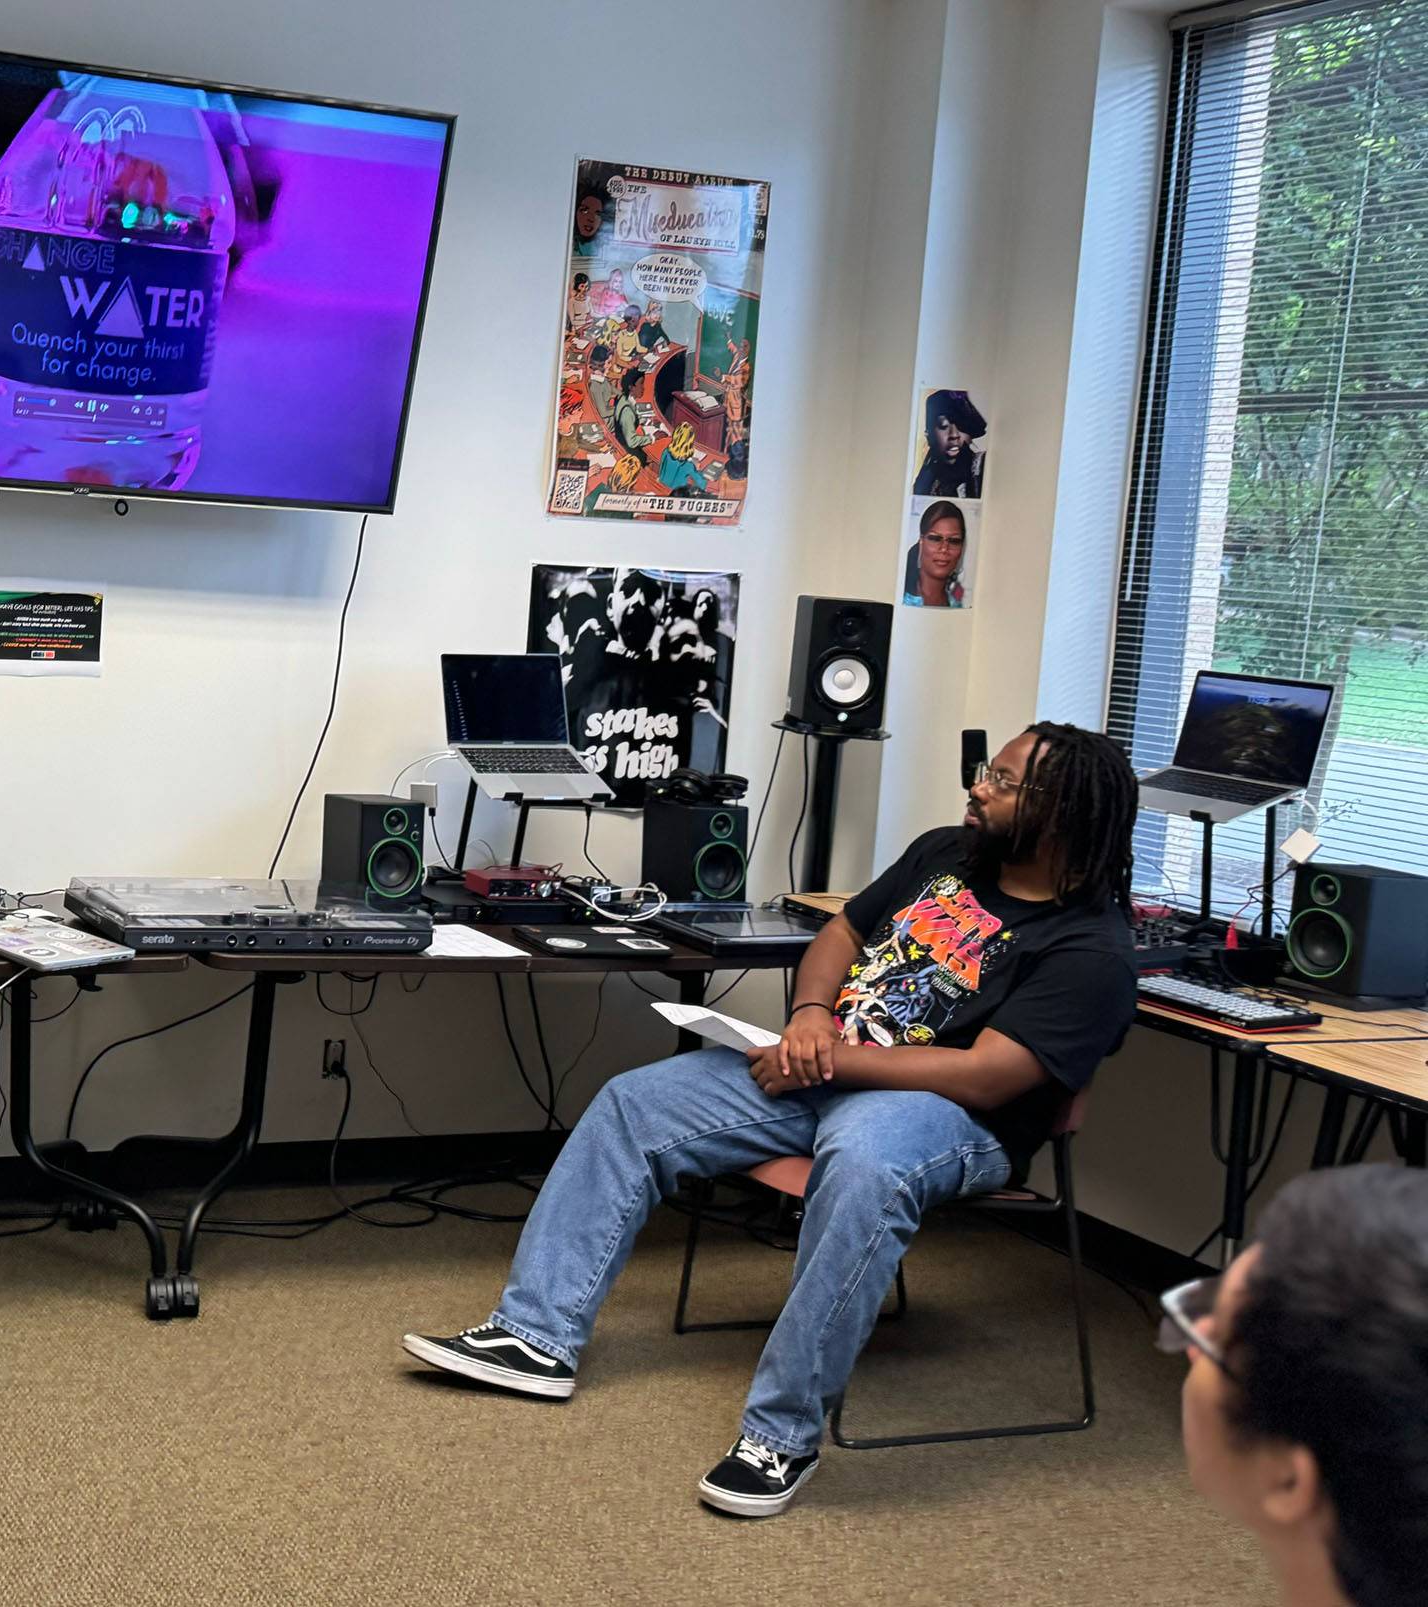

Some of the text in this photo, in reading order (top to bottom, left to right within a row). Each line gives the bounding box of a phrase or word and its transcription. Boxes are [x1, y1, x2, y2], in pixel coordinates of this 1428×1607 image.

[625, 166, 648, 178] THE
[652, 169, 690, 184] DEBUT
[627, 184, 648, 194] THE
[660, 233, 673, 243] OF
[636, 263, 702, 277] HOW MANY PEOPLE
[639, 274, 700, 287] HERE HAVE EVER
[643, 283, 663, 292] BEEN
[671, 286, 694, 295] LOVE?
[59, 275, 204, 339] WATER
[706, 303, 735, 327] LOVE
[11, 321, 185, 363] Quench your thirst
[41, 351, 157, 388] for change.
[632, 496, 643, 511] of
[585, 707, 679, 741] stakes
[584, 741, 679, 779] is high
[934, 889, 1003, 939] STAR
[141, 935, 175, 945] serato
[363, 936, 406, 945] Pioneer
[892, 898, 985, 990] WAS
